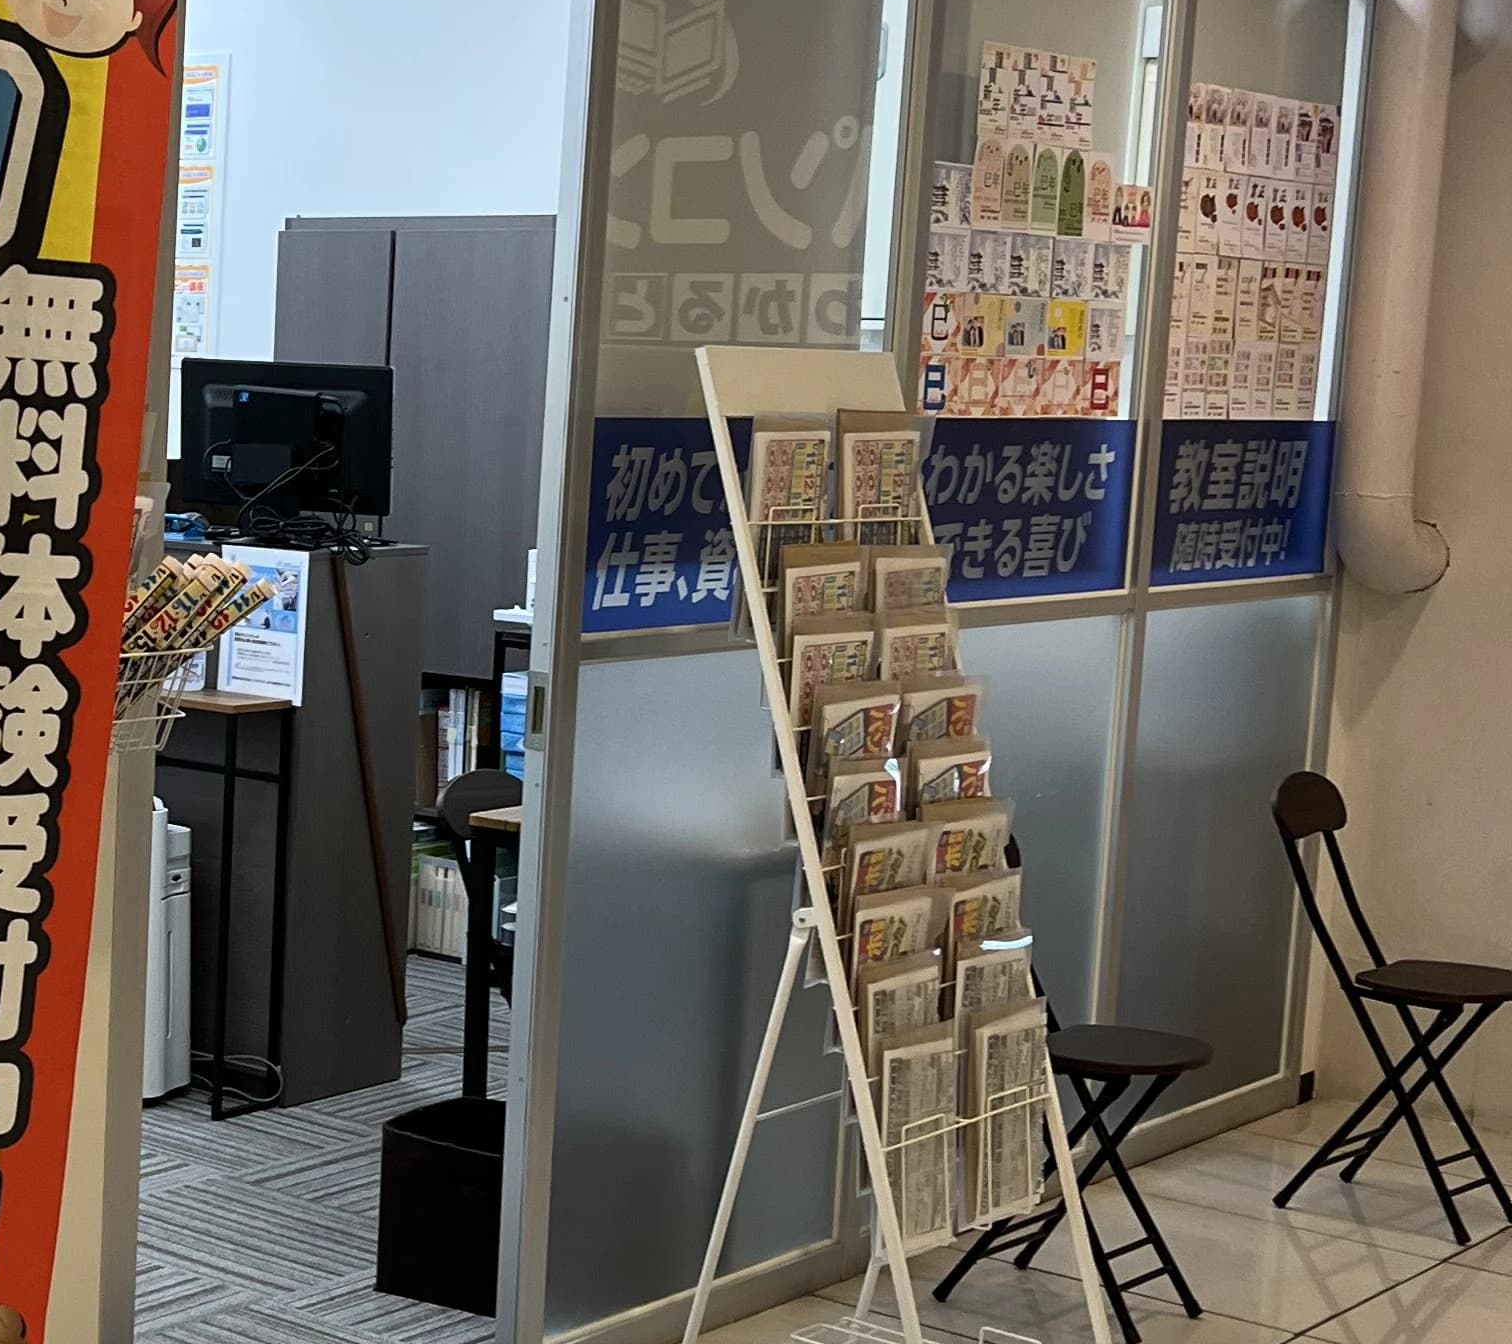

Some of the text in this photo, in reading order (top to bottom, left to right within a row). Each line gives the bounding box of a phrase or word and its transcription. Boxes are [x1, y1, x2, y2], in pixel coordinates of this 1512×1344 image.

[605, 444, 731, 522] 初めて
[1169, 440, 1309, 514] 教室説明
[592, 529, 739, 610] 仕事、資
